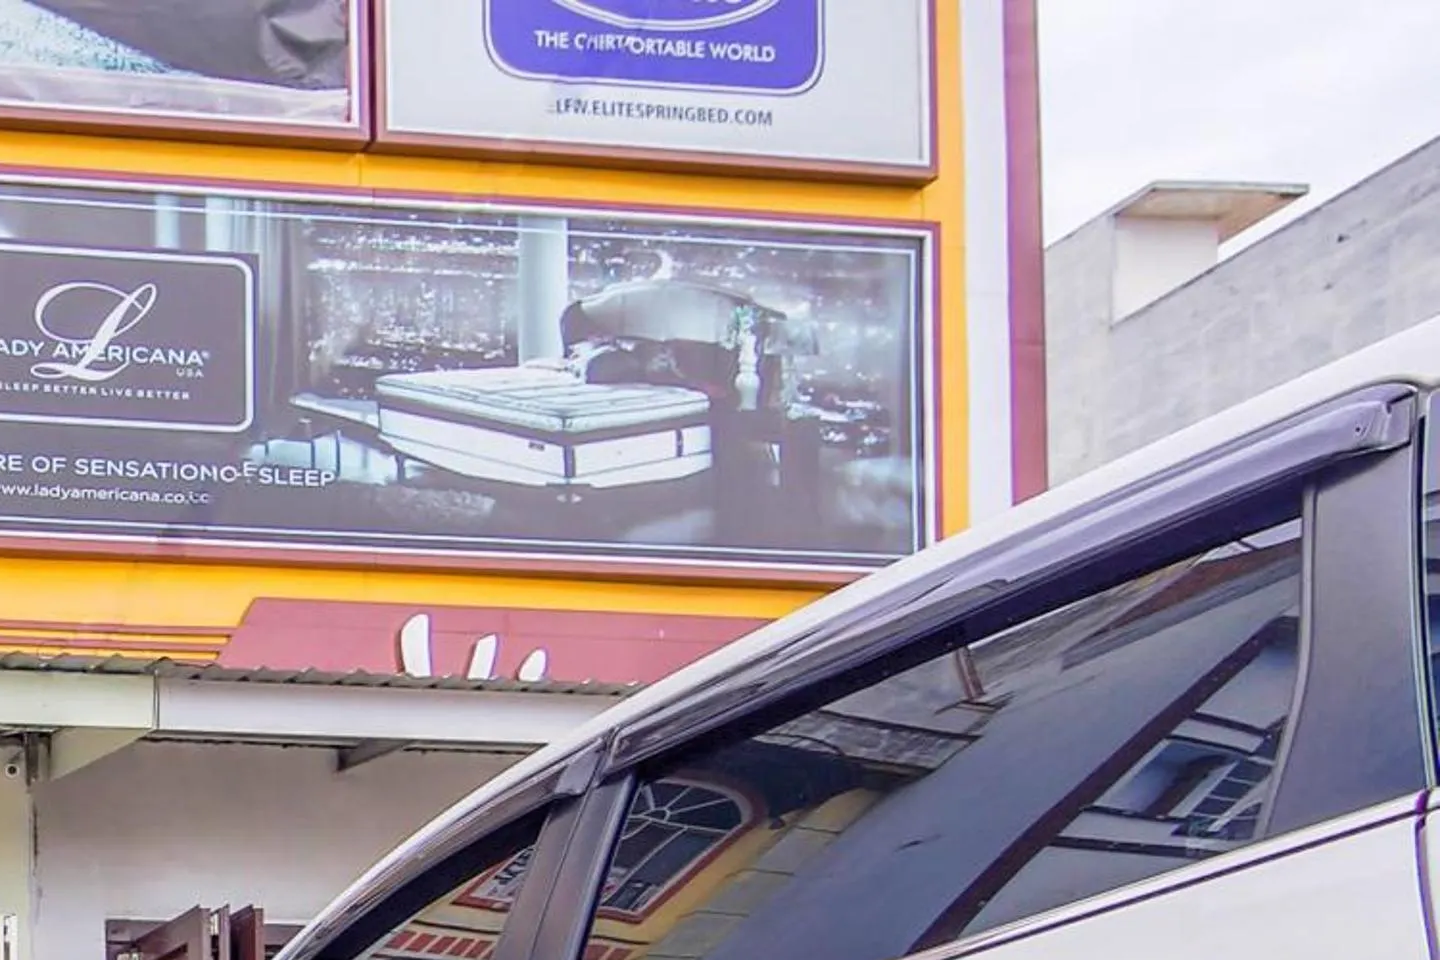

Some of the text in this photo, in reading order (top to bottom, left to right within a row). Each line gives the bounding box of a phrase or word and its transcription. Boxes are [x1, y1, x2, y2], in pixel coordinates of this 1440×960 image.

[534, 30, 569, 49] THE
[709, 43, 777, 63] WORLD
[176, 367, 204, 378] USA
[43, 383, 97, 396] BETTER
[100, 387, 133, 397] LIVE
[136, 388, 190, 400] BETTER
[31, 456, 67, 474] OF
[74, 458, 218, 482] SENSATION
[259, 466, 336, 488] SLEEP
